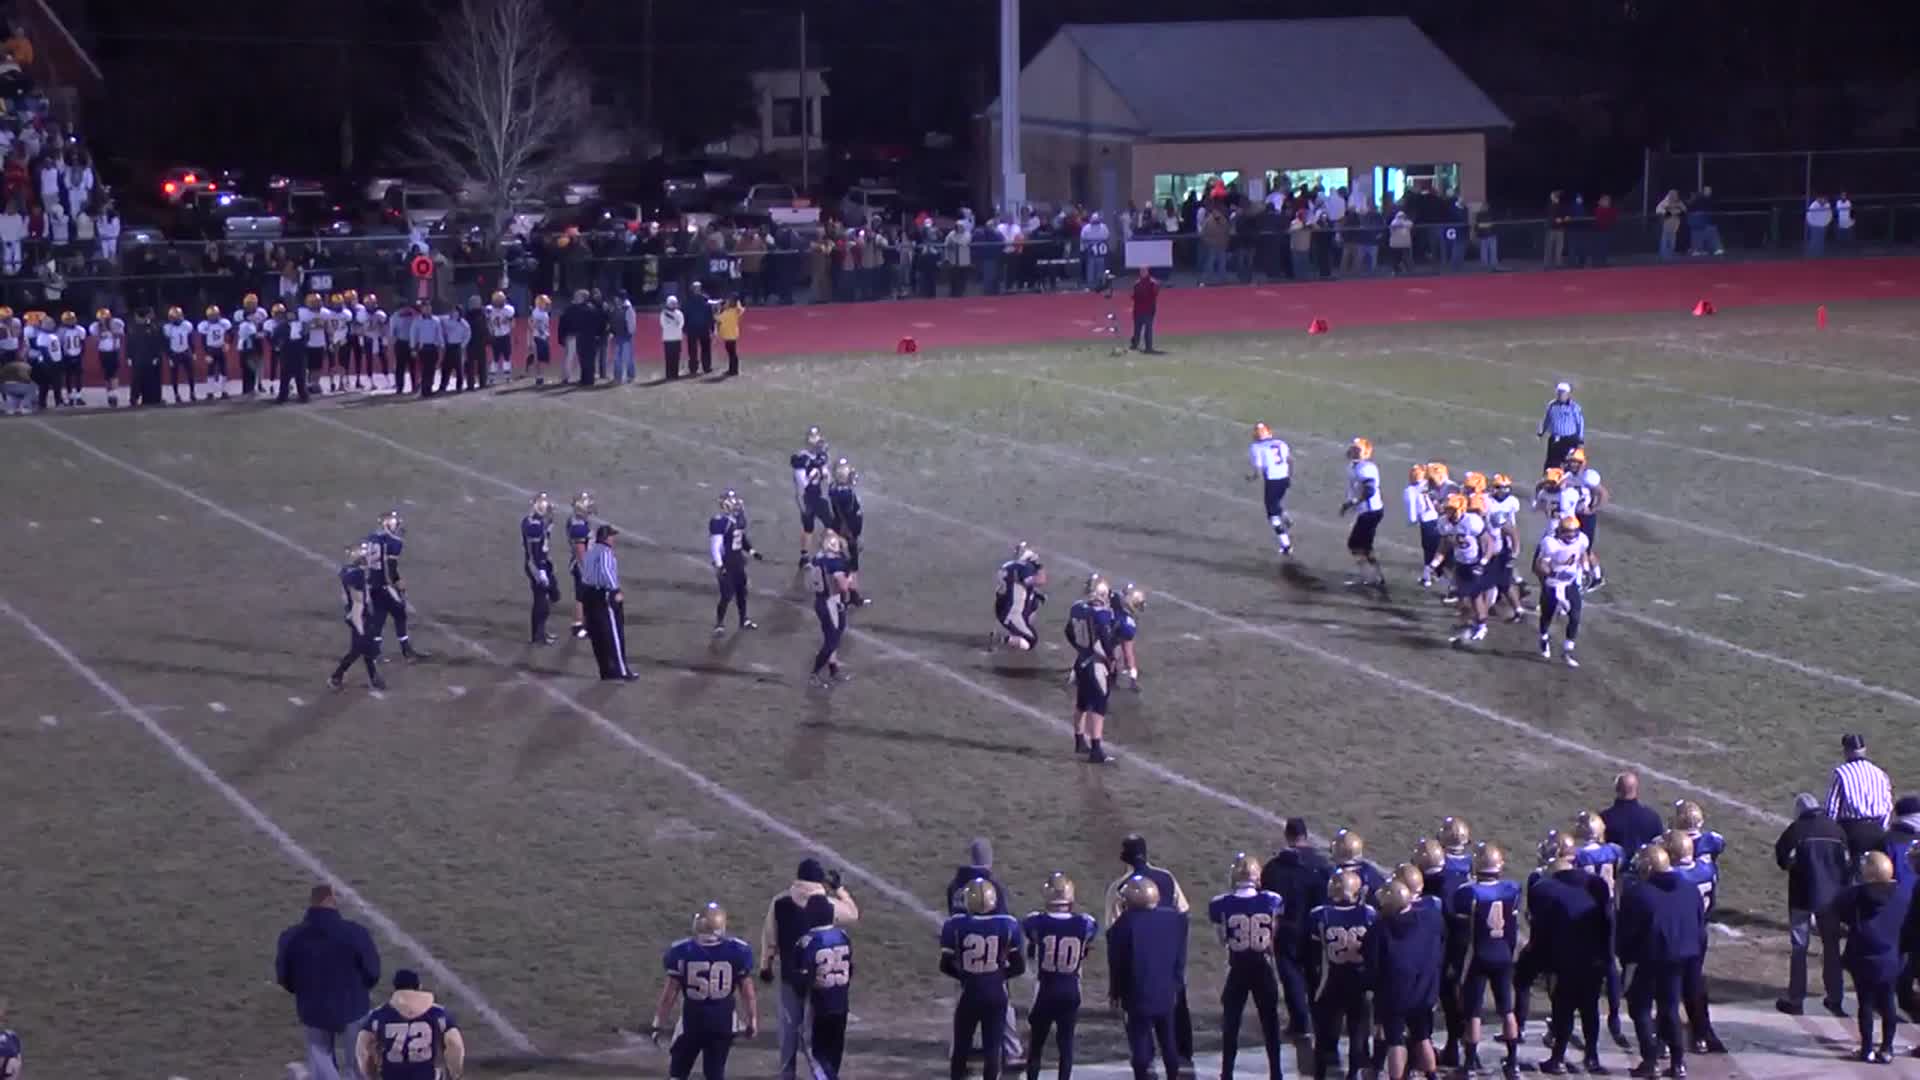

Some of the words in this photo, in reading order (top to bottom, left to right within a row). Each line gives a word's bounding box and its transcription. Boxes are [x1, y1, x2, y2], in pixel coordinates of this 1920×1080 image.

[1228, 913, 1272, 952] 36
[1486, 900, 1505, 938] 4
[815, 945, 849, 989] 25
[962, 933, 999, 974] 21
[1041, 935, 1081, 974] 10
[686, 961, 733, 1000] 50
[384, 1021, 433, 1063] 72
